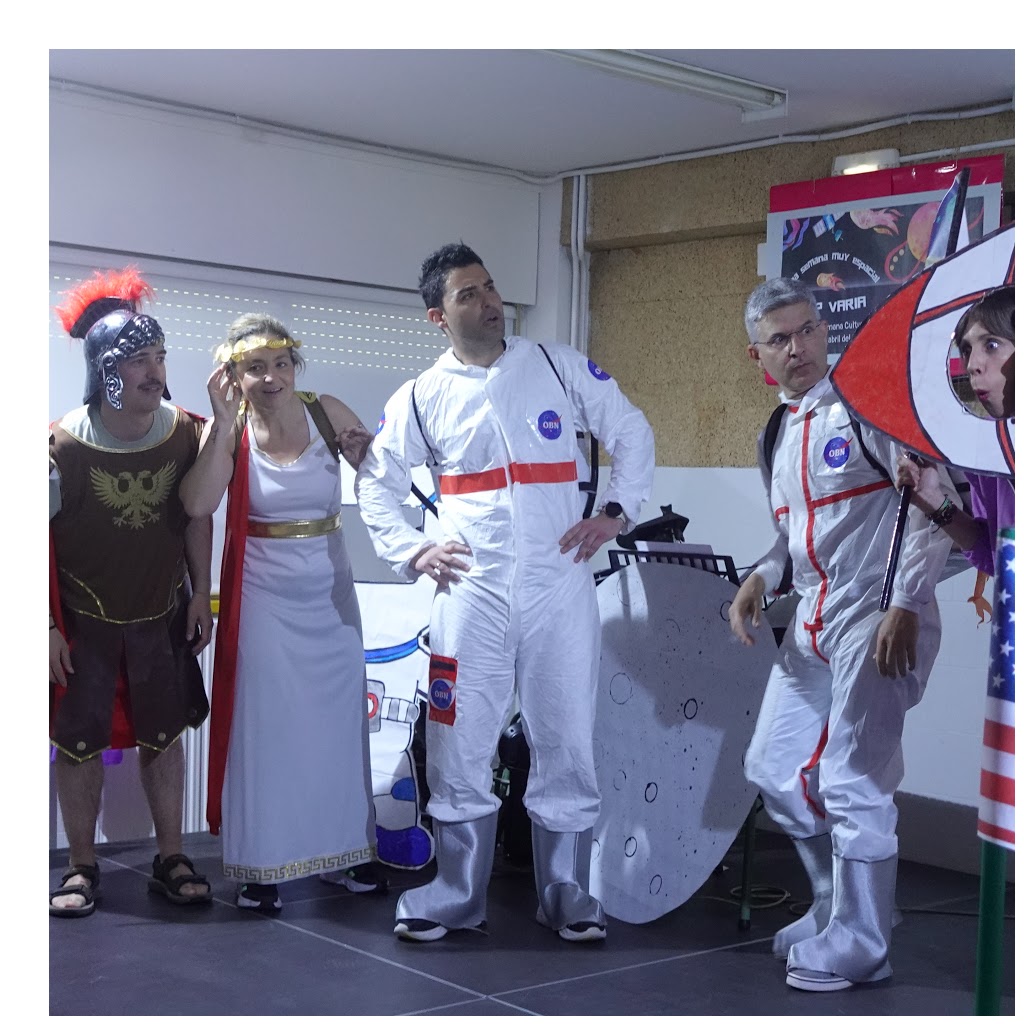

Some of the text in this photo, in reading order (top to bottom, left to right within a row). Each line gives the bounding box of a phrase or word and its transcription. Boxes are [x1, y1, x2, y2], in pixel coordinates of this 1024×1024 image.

[800, 253, 829, 275] semana
[852, 257, 880, 283] espacial
[828, 296, 867, 313] VARIA
[828, 333, 851, 343] abril del
[542, 421, 560, 429] OBN
[828, 447, 846, 457] OBN
